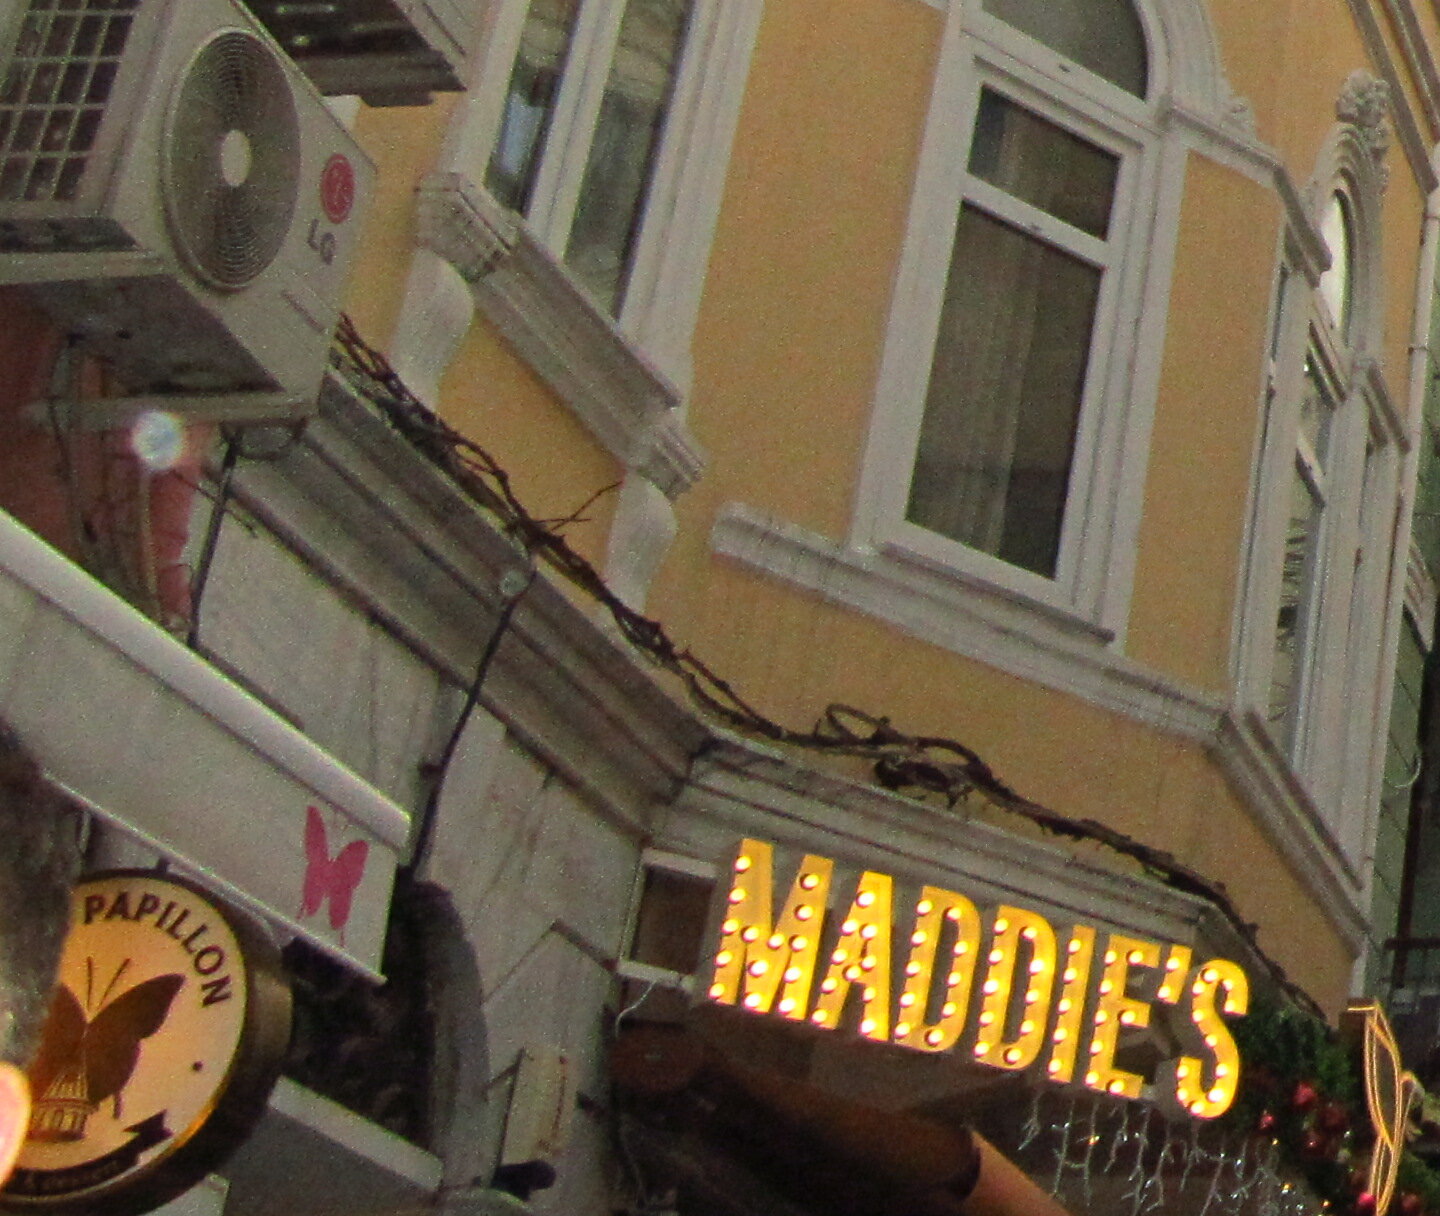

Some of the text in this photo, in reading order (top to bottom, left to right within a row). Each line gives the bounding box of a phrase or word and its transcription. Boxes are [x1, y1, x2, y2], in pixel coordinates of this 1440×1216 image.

[306, 218, 336, 265] LG
[84, 891, 233, 1007] PAPILLON
[709, 838, 1248, 1119] MADDIE'S
